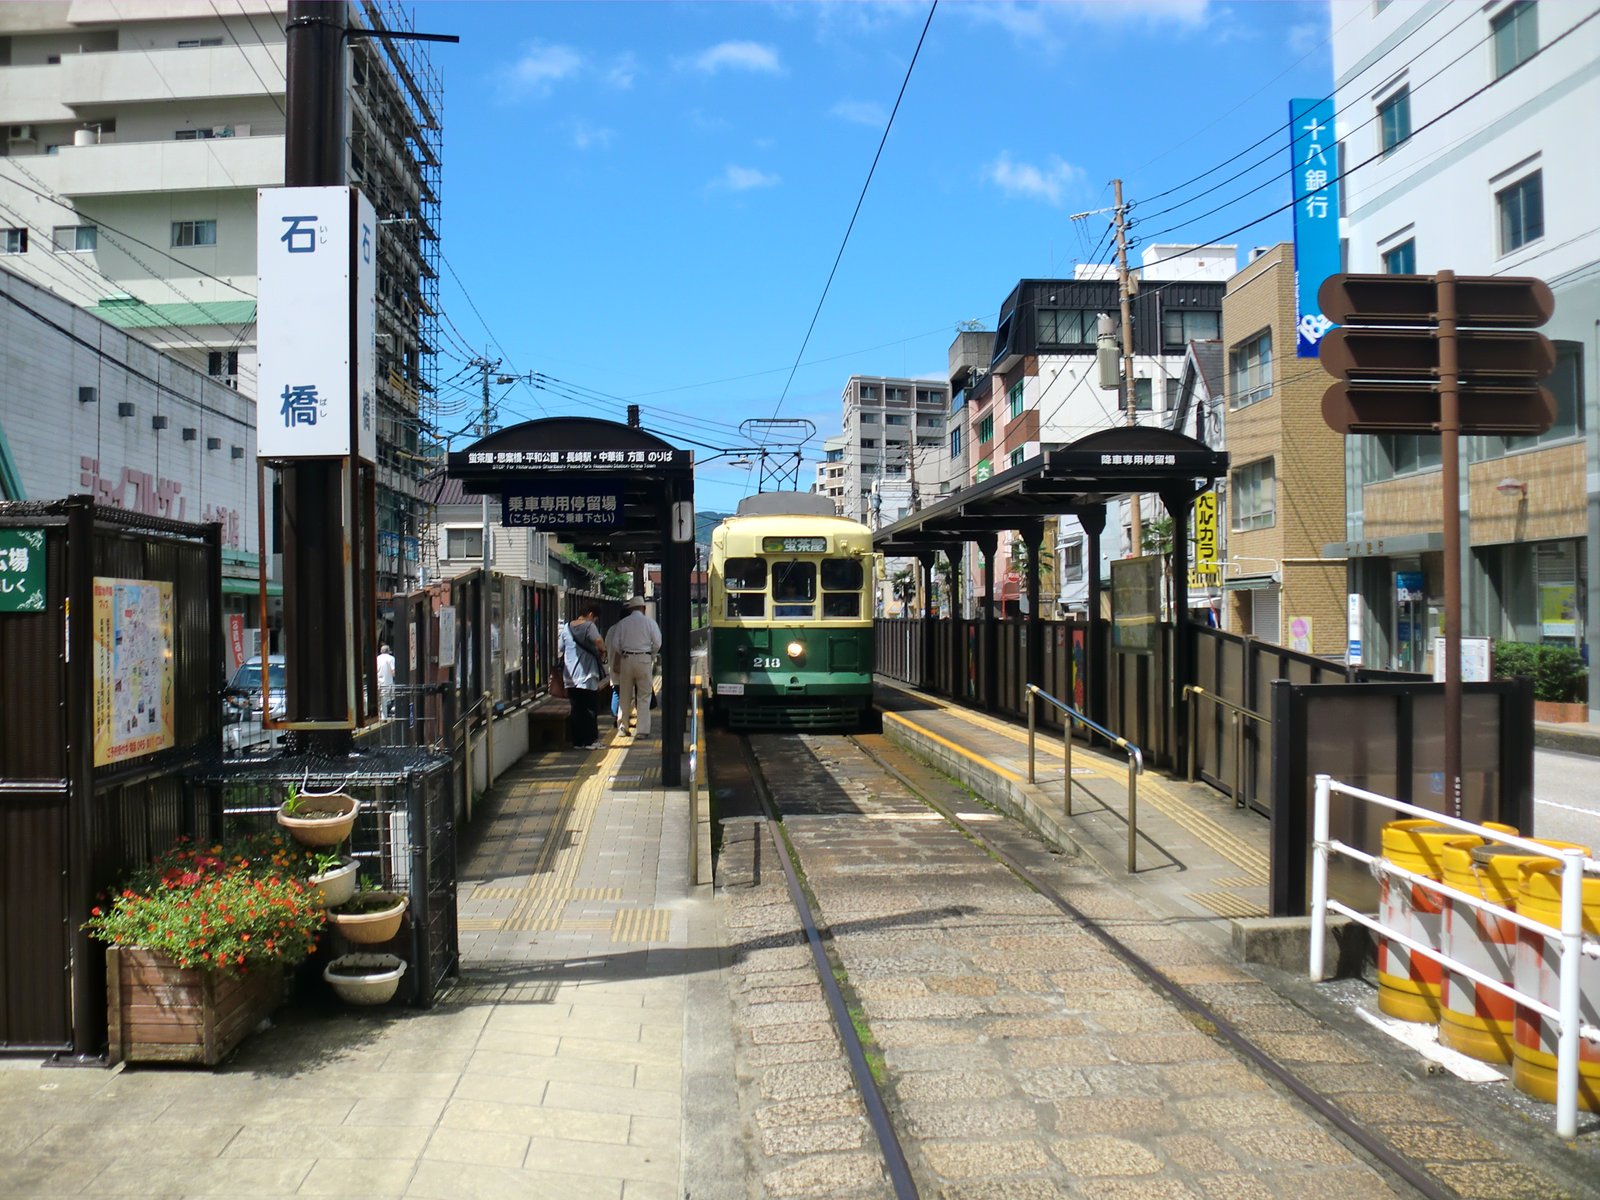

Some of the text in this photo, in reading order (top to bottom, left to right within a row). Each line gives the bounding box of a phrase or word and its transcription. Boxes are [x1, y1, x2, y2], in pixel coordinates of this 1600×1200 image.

[1303, 118, 1328, 218] 十八銀行
[320, 225, 327, 244] いし
[627, 451, 645, 463] 方面
[648, 450, 673, 463] のりば
[509, 496, 617, 512] 乗車専用停留場
[1199, 495, 1214, 570] ベルカラー
[0, 578, 26, 593] しく
